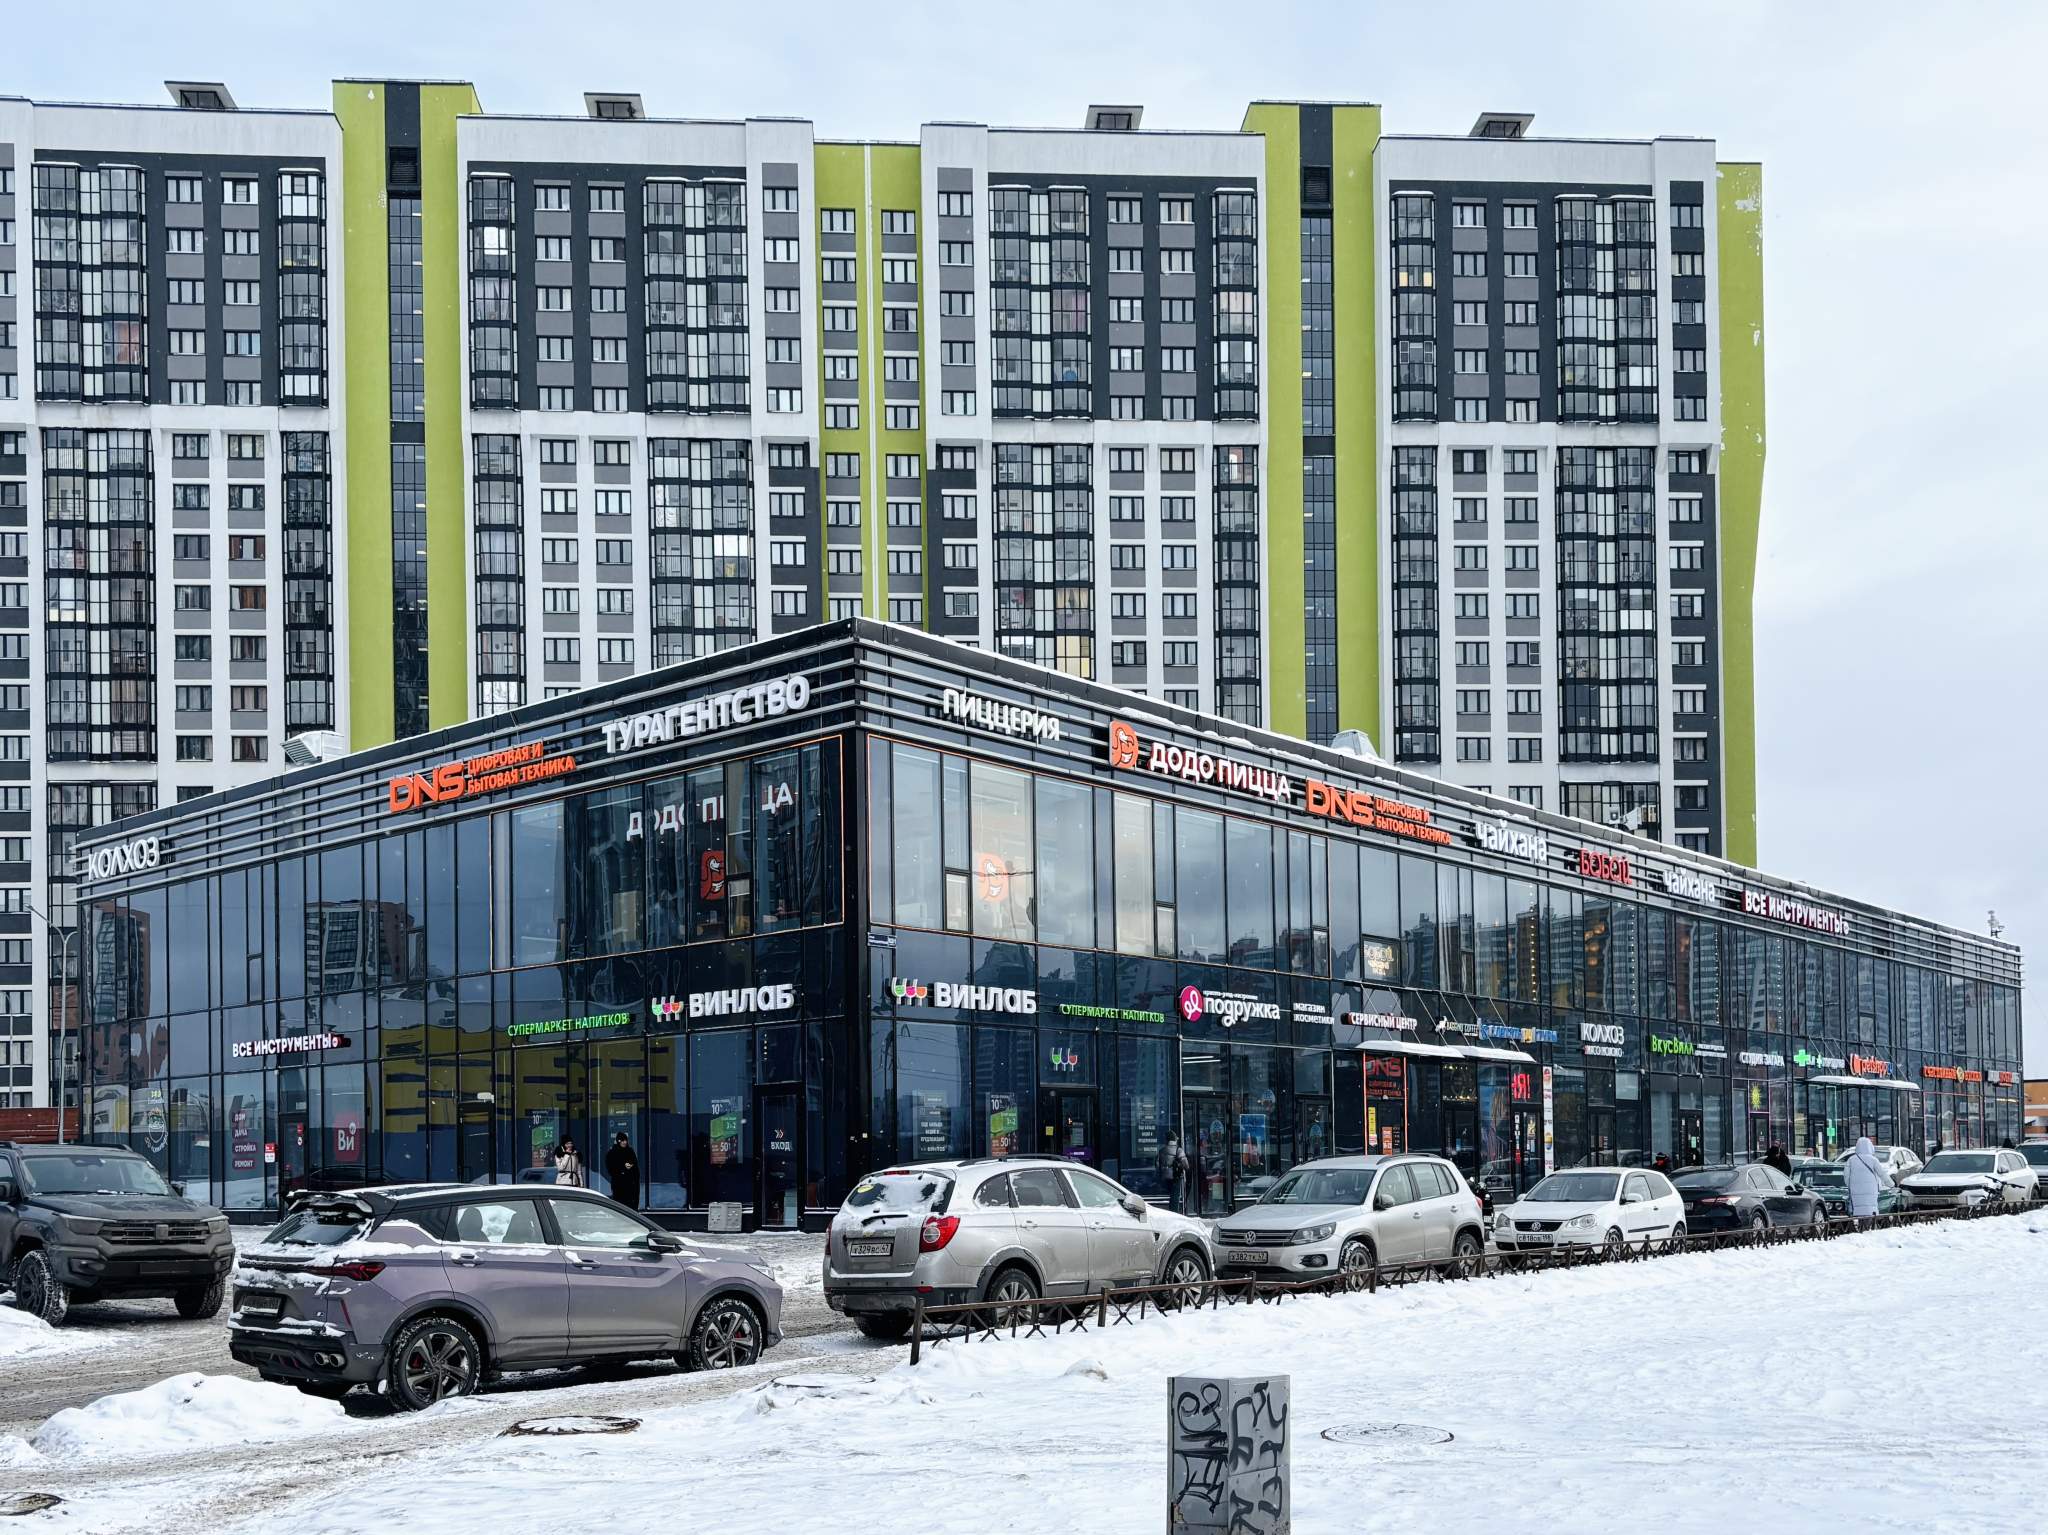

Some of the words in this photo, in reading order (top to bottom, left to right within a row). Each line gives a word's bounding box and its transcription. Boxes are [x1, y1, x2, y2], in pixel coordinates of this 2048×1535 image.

[602, 675, 810, 753] ТУРАГЕНТСТВО
[943, 688, 1060, 742] ПИЦЦЕРИЯ
[467, 747, 529, 775] ЦИФРОВАЯ
[532, 741, 544, 758] И
[467, 771, 519, 794] БЫТОВАЯ
[520, 755, 577, 781] ТЕХНИКА
[1149, 742, 1214, 783] ДОДО
[1217, 759, 1291, 801] ПИЦЦА
[389, 762, 465, 813] DNS
[1306, 777, 1375, 827] DNS
[1375, 798, 1423, 821] ЦИФРОВАЯ
[1424, 809, 1430, 823] И
[1375, 816, 1415, 836] БЫТОВАЯ
[1416, 825, 1451, 845] ТЕХНИКА
[1475, 819, 1547, 862] чайхана
[88, 836, 160, 881] КОЛХОЗ
[1662, 868, 1716, 903] чайхана
[1745, 890, 1767, 915] ВСЕ
[1768, 896, 1843, 934] ИНСТРУМЕНТЫ
[689, 983, 795, 1018] ВИНЛАБ
[934, 982, 1037, 1014] ВИНЛАБ
[1059, 1003, 1120, 1020] СУПЕРМАРКЕТ
[1122, 1010, 1166, 1024] НАПИТКОВ
[1203, 997, 1280, 1027] подружка
[507, 1018, 573, 1036] СУПЕРМАРКЕТ
[574, 1012, 630, 1030] НАПИТКОВ
[1350, 1012, 1396, 1030] СЕРВИСНЫЙ
[1395, 1017, 1418, 1032] ЦЕНТР
[1581, 1023, 1625, 1045] КОЛХОЗ
[232, 1041, 253, 1058] ВСЕ
[254, 1033, 332, 1056] ИНСТРУМЕНТЫ
[234, 1143, 257, 1153] СТРОЙКА
[770, 1141, 790, 1152] ВХОД
